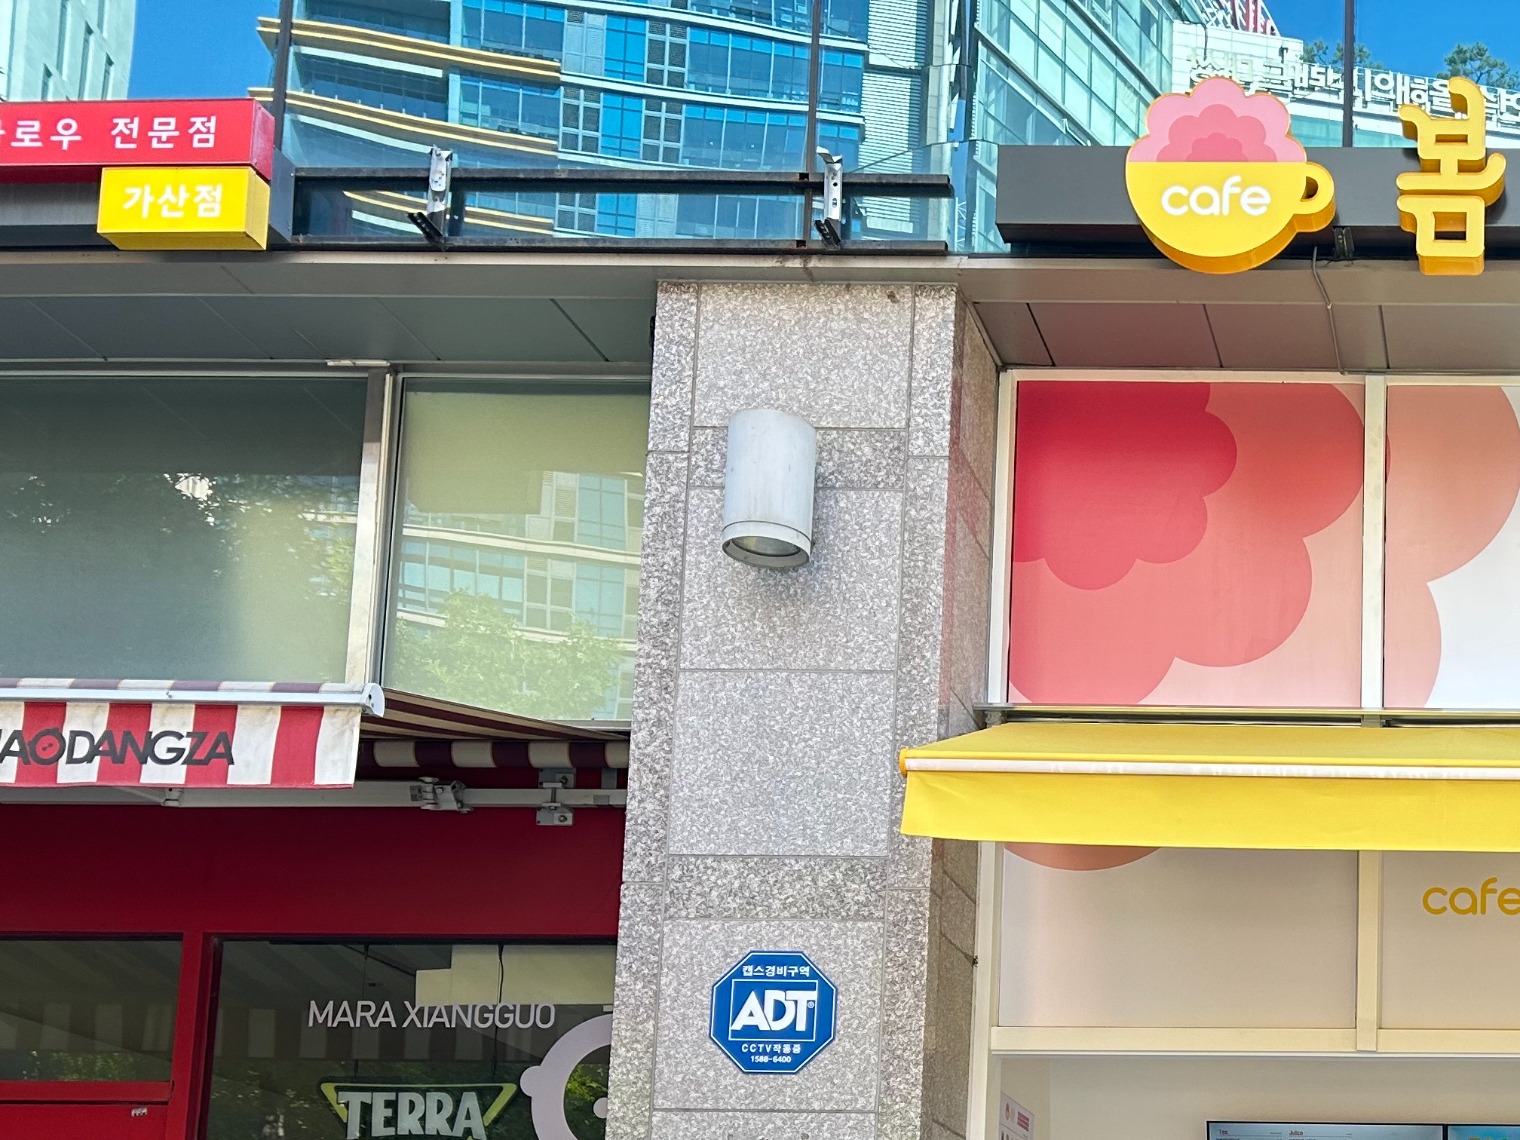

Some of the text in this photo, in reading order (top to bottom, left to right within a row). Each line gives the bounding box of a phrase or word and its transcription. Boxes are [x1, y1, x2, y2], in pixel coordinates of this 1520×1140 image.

[0, 115, 217, 150] 로우 전문점
[123, 183, 222, 219] 가산점
[1161, 175, 1271, 217] cafe
[0, 727, 235, 766] AODANGZA
[742, 965, 811, 977] 캡스경비구역
[308, 1000, 556, 1029] MARA XIANGGUO
[731, 989, 817, 1031] ADT
[741, 1043, 801, 1054] CCTV작동중
[337, 1091, 487, 1140] TERRA
